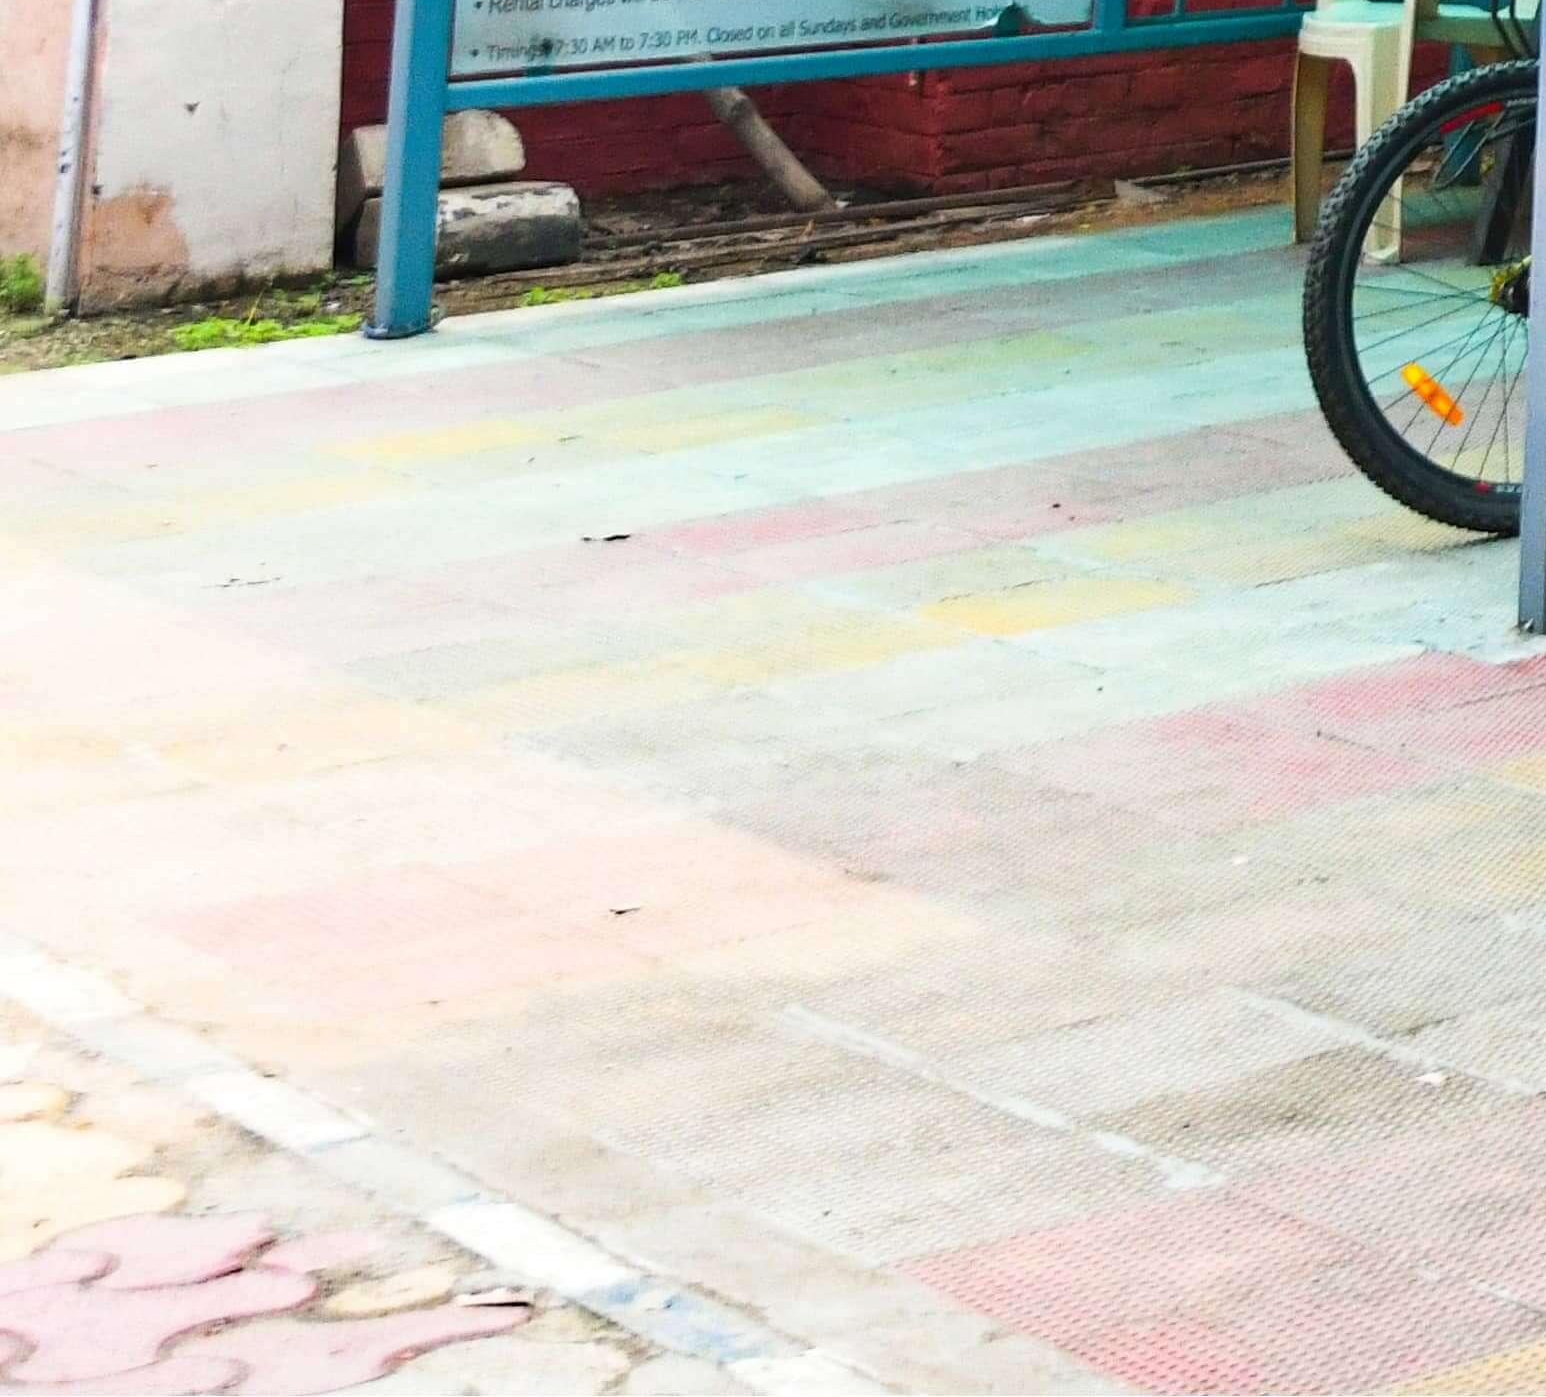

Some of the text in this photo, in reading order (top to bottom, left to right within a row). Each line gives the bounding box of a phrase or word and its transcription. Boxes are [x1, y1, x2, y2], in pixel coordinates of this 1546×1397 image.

[620, 36, 635, 50] to
[639, 31, 673, 50] 7:30
[706, 26, 753, 43] Closed
[757, 26, 775, 38] on
[800, 16, 857, 37] Sundays
[861, 14, 886, 30] and
[889, 9, 971, 28] Government
